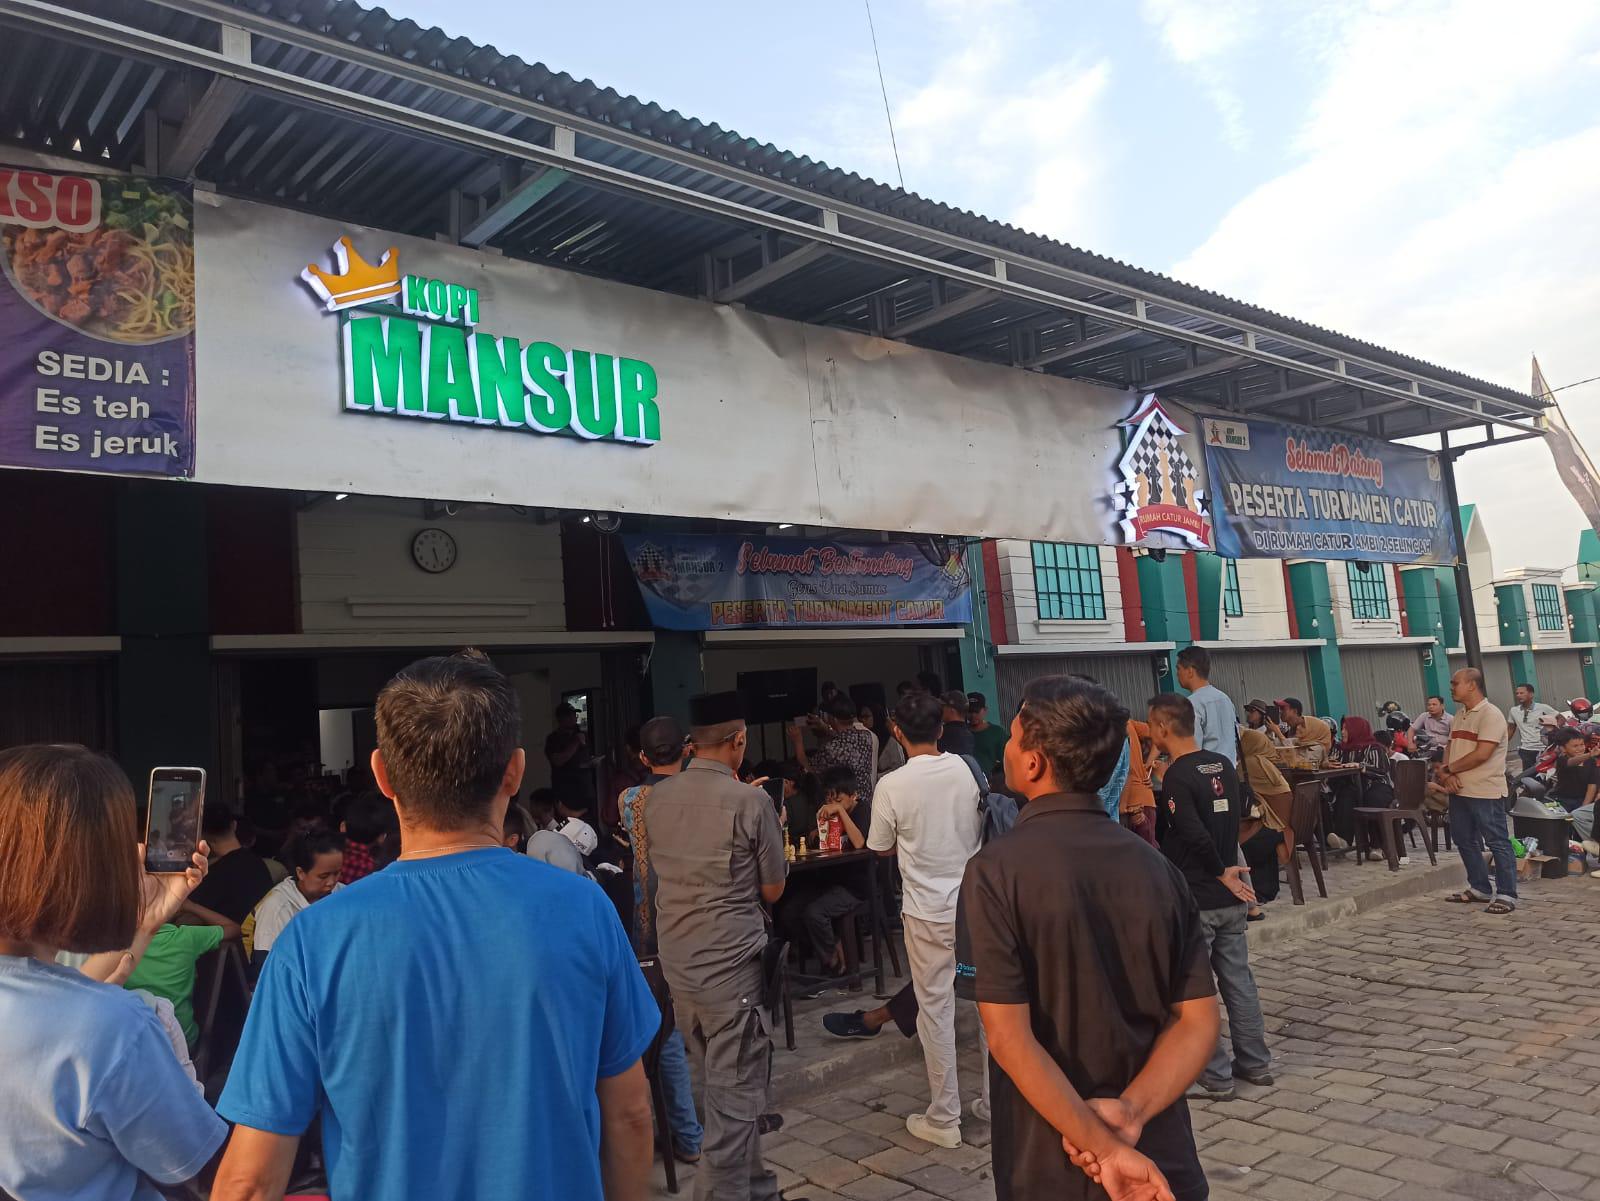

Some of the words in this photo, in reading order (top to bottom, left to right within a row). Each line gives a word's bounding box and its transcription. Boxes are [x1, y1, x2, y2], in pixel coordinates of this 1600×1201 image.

[402, 274, 480, 327] KOPI
[36, 350, 150, 385] SEDIA
[343, 316, 661, 445] MANSUR
[36, 387, 81, 415] Es
[93, 395, 150, 419] teh
[35, 425, 80, 452] Es
[90, 430, 179, 458] jeruk
[1286, 437, 1340, 475] Selamat
[1338, 444, 1383, 489] Datang
[1140, 512, 1161, 524] RUMAH
[1162, 512, 1182, 522] CATUR
[1229, 483, 1308, 519] PESERTA
[1394, 497, 1438, 528] CATUR
[737, 542, 818, 576] Selamat
[1254, 531, 1269, 549] DI
[1269, 531, 1313, 550] RUMAH
[1313, 532, 1354, 550] CATUR
[1379, 535, 1388, 553] 2
[1387, 536, 1432, 555] SELINCAH
[849, 580, 888, 595] Sumus
[711, 600, 788, 625] PESERTA
[793, 600, 893, 623] TURNAMENT
[895, 600, 944, 621] CATUR
